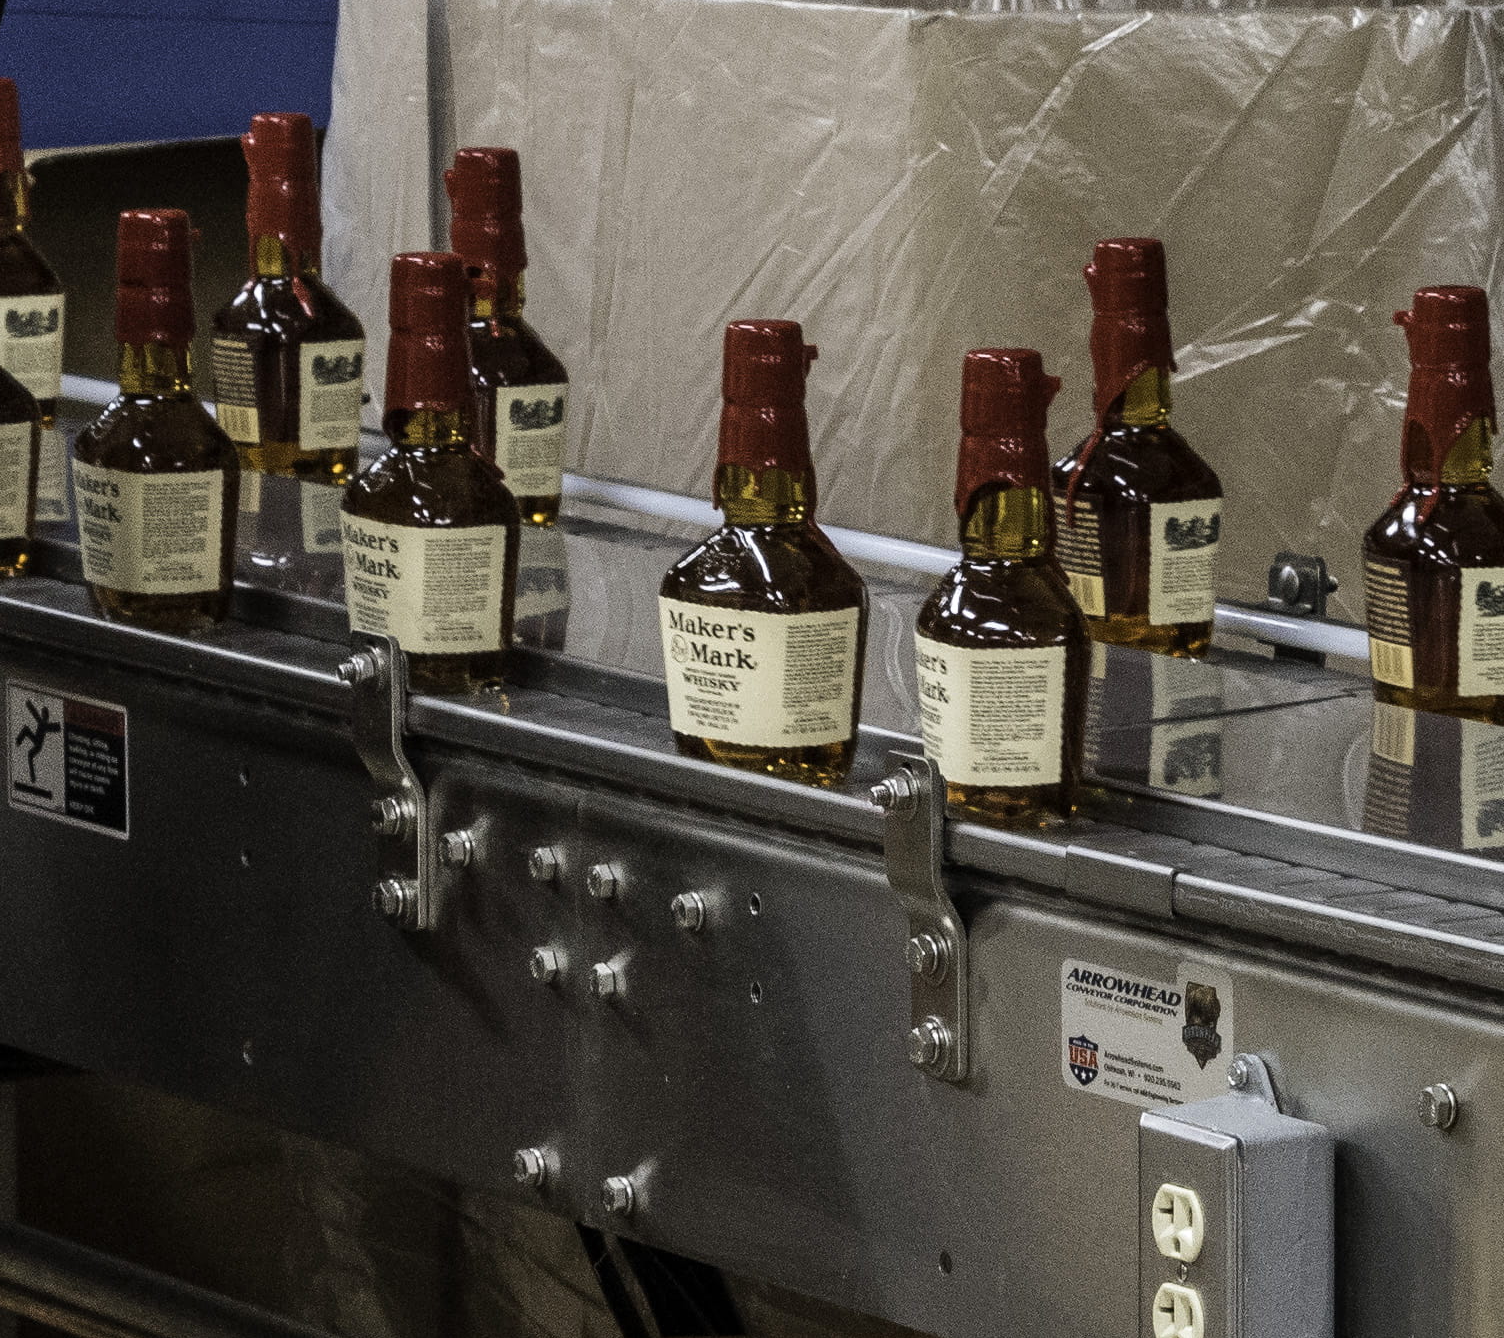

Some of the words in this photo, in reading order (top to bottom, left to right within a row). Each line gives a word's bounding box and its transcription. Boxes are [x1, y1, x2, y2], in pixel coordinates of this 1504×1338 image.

[354, 551, 401, 580] Mark
[668, 609, 756, 643] Maker's
[689, 640, 757, 671] Mark
[682, 671, 742, 693] WHISKY
[1065, 982, 1114, 1002] CONVEYOR
[1113, 994, 1180, 1018] CORPORATION
[1067, 967, 1183, 1008] ARROWHEAD
[1068, 1045, 1099, 1070] USA
